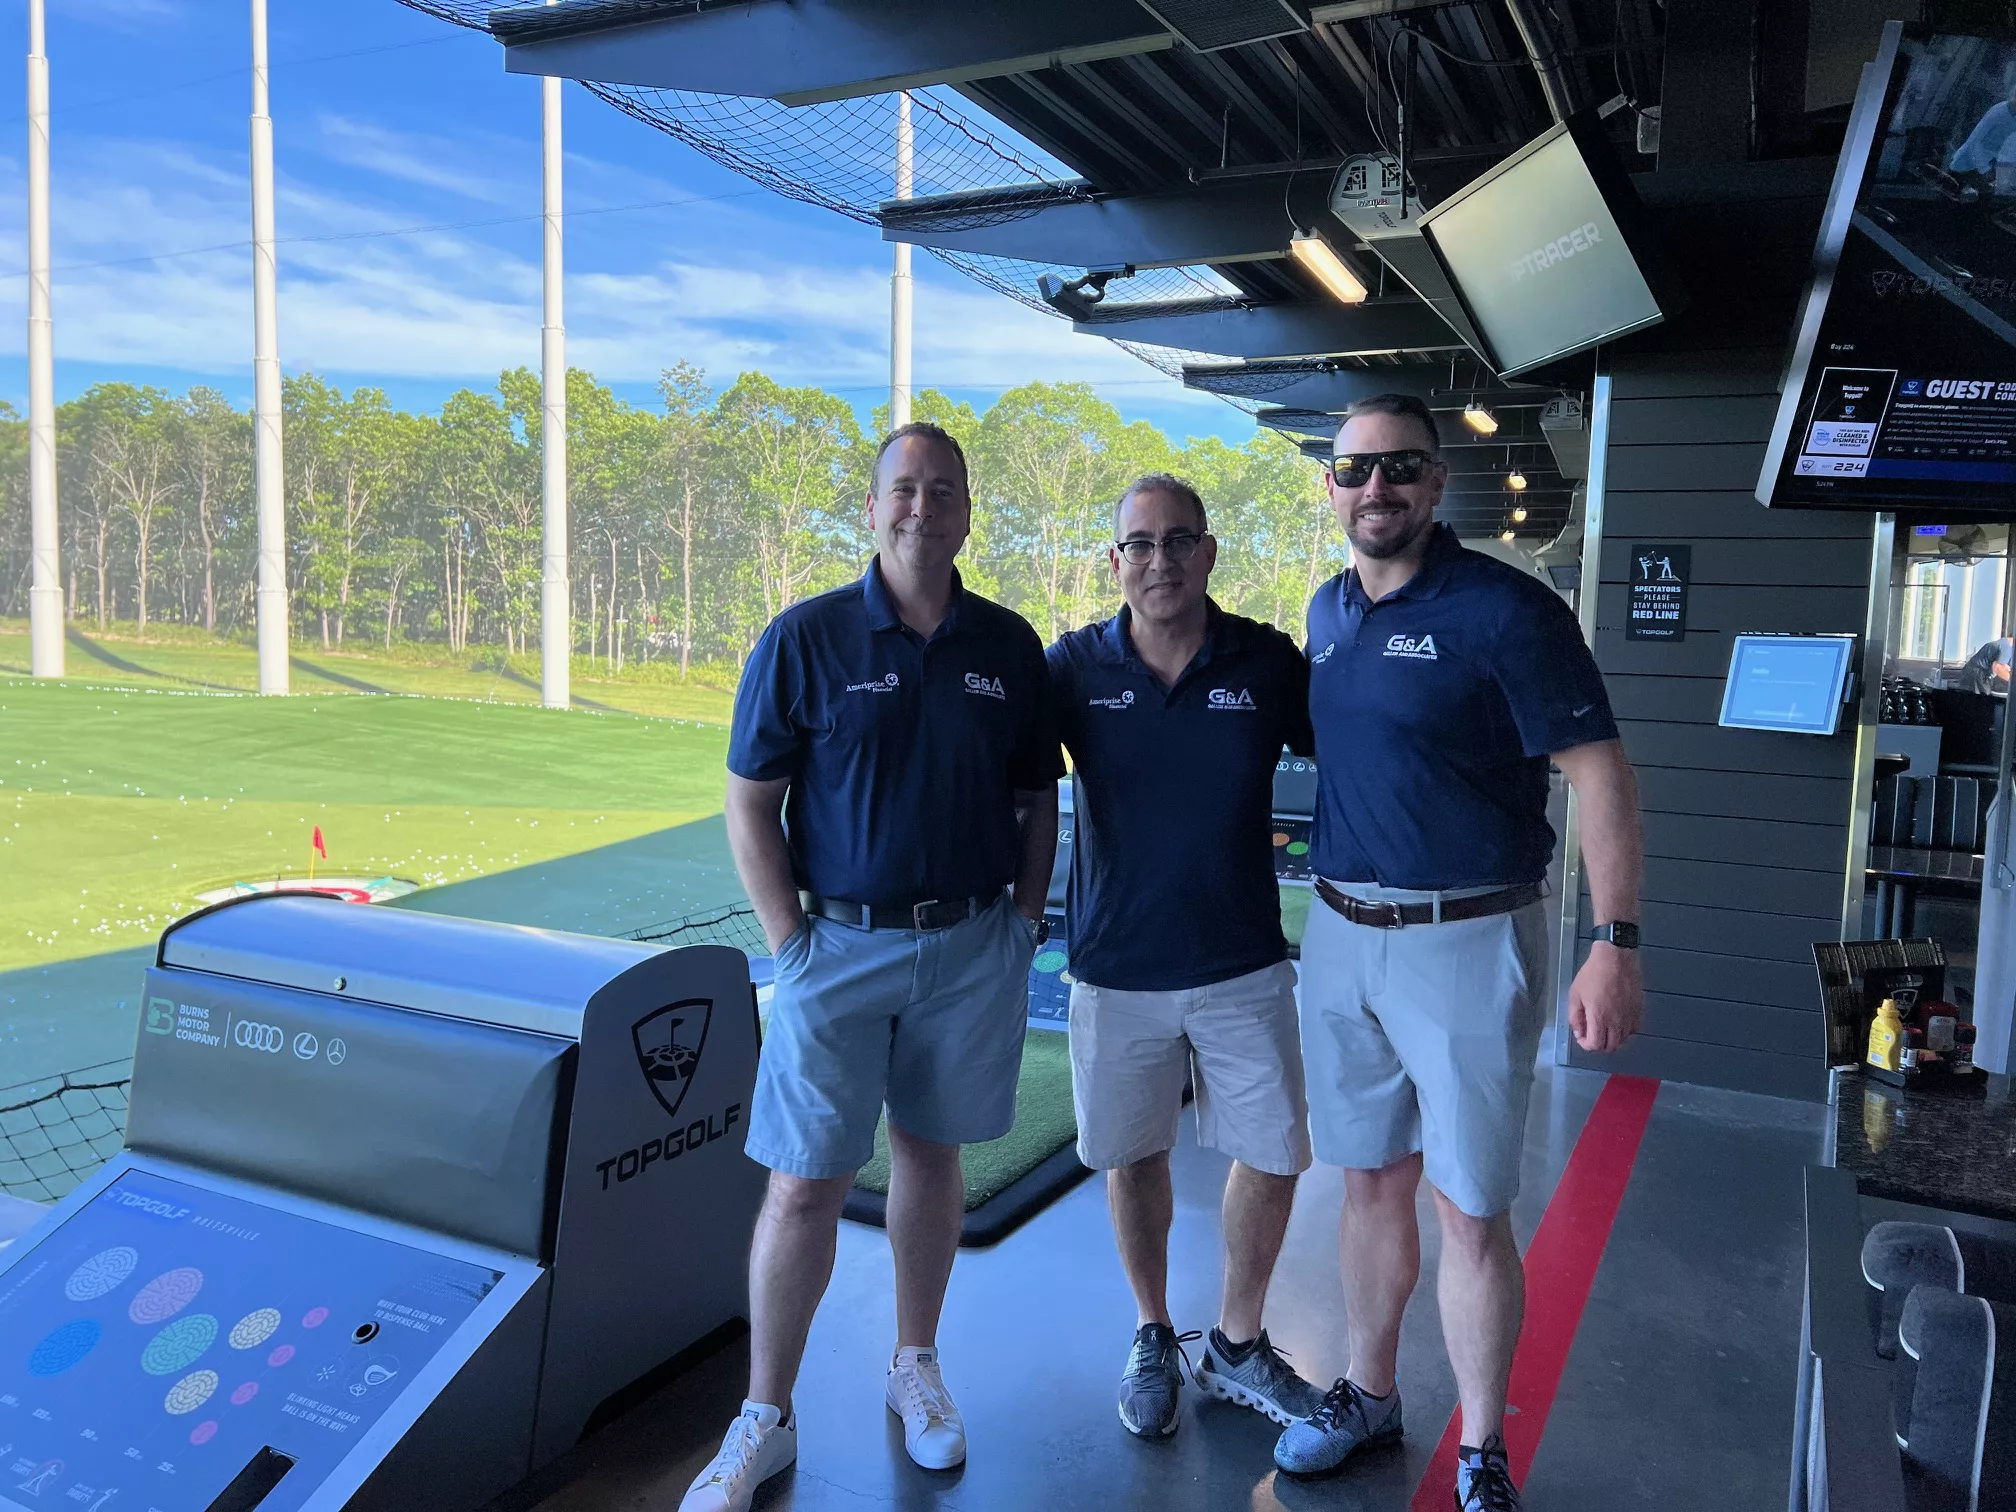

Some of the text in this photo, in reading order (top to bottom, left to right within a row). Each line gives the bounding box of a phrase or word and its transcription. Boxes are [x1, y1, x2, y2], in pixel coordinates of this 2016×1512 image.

[1508, 221, 1603, 283] PTRACER
[1926, 379, 1996, 400] GUEST
[1994, 391, 2016, 401] CON
[1834, 463, 1865, 472] 224
[1634, 585, 1681, 593] SPECTATORS
[1632, 610, 1680, 620] RED LINE
[1387, 634, 1437, 654] G&A
[846, 681, 885, 692] Ameriprise
[964, 672, 1005, 695] G&A
[1208, 688, 1254, 705] G&A
[179, 1004, 210, 1018] BURNS
[177, 1016, 210, 1032] MOTOR
[175, 1029, 221, 1047] COMPANY
[596, 1102, 741, 1191] TOPGOLF
[114, 1191, 261, 1241] TOPGOLF HOLTSVILLE
[374, 1309, 384, 1318] TO
[383, 1312, 415, 1328] DISPENSE
[376, 1299, 447, 1326] WAVE YOUR CLUB HERE
[286, 1392, 361, 1425] BLINKING LIGHT MEANS
[281, 1404, 348, 1433] BALL IS ON THE WAY!
[80, 1428, 96, 1439] 90
[124, 1447, 140, 1458] 50
[157, 1461, 174, 1472] 25
